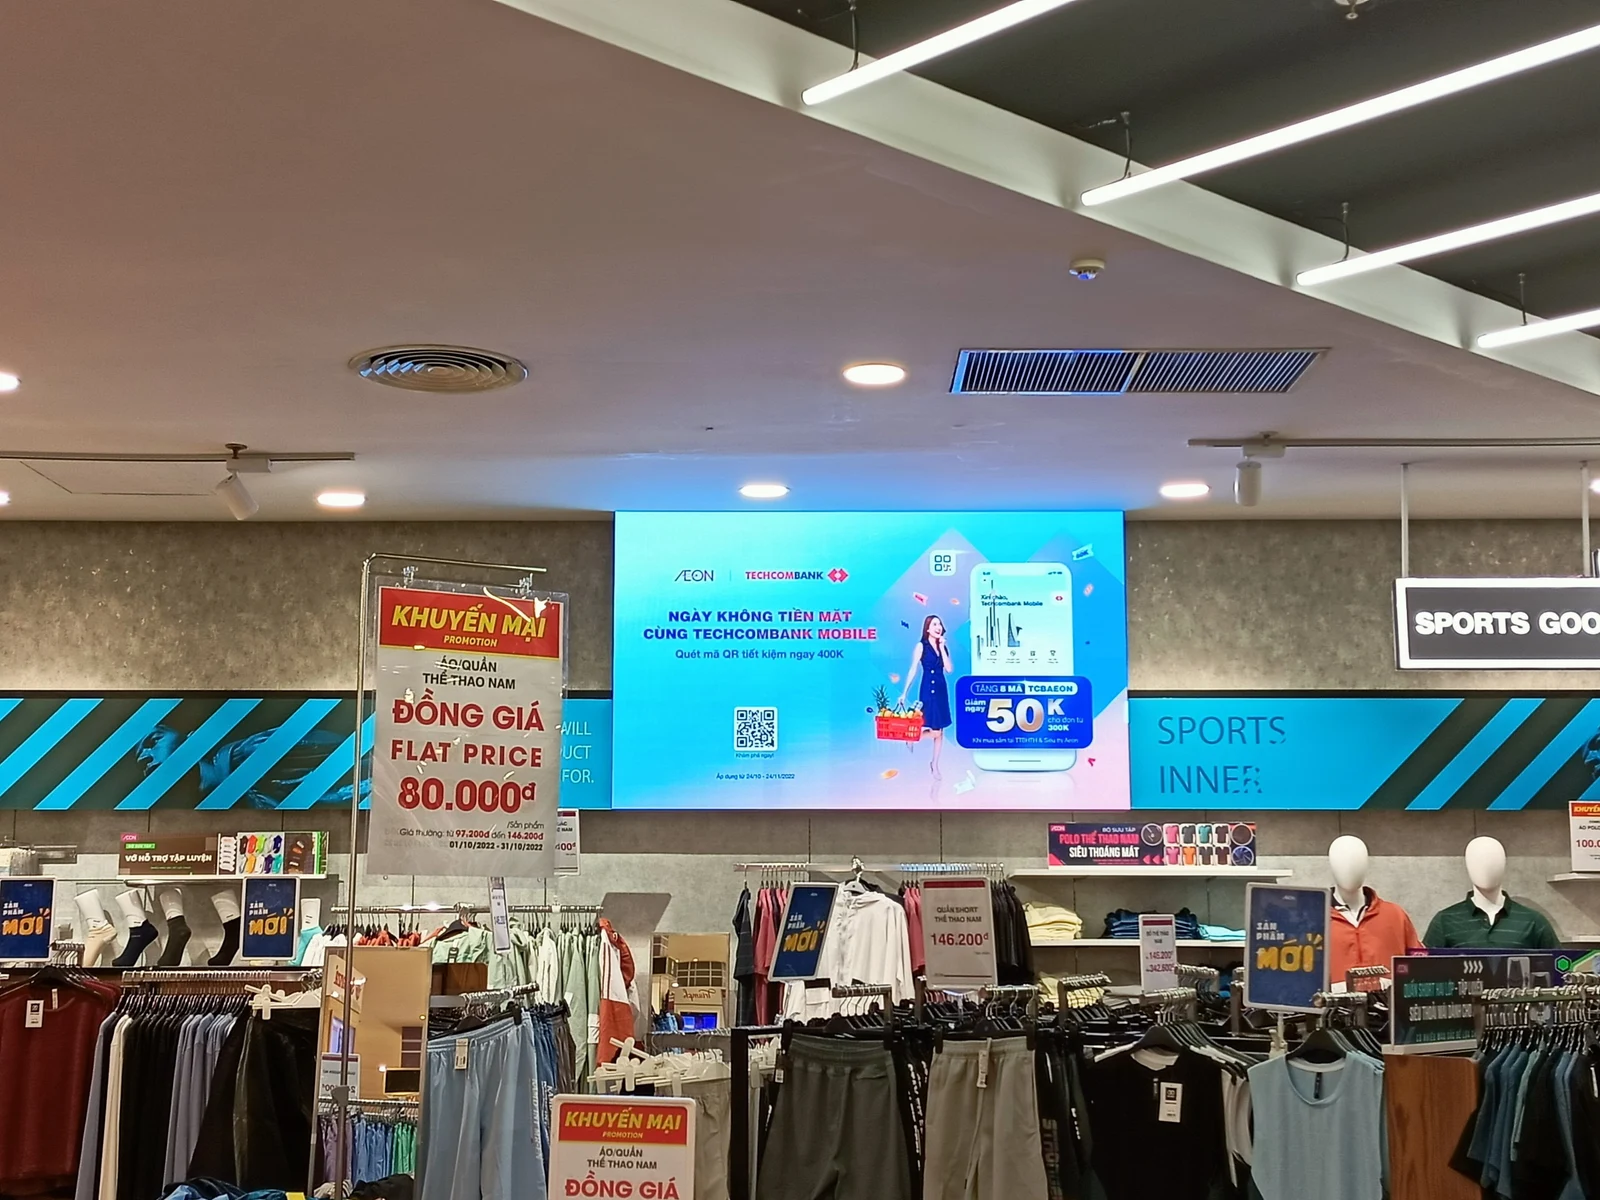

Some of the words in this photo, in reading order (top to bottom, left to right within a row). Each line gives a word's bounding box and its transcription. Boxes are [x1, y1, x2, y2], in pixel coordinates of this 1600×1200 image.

[746, 571, 824, 580] TECHCOMBANK
[392, 604, 498, 634] KHUYẾN
[501, 614, 546, 642] MẠI
[669, 608, 712, 622] NGÀY
[717, 608, 772, 622] KHÔNG
[778, 607, 814, 622] TIỀN
[819, 610, 852, 624] MẶT
[1415, 611, 1530, 634] SPORTS
[443, 634, 498, 647] PROMOTION
[644, 625, 688, 640] CÙNG
[693, 628, 812, 640] TECHCOMBANK
[818, 628, 877, 640] MOBILE
[676, 649, 700, 659] Quét
[704, 650, 719, 658] mã
[723, 650, 739, 659] QR
[742, 648, 759, 658] tiết
[762, 649, 786, 660] kiệm
[790, 651, 814, 661] ngay
[817, 650, 844, 658] 400K
[422, 670, 447, 685] THỂ
[452, 675, 485, 687] THAO
[488, 678, 516, 689] NAM
[392, 688, 484, 727] ĐỒNG
[492, 700, 544, 732] GIÁ
[986, 698, 1044, 732] 50
[1048, 698, 1065, 715] K
[1158, 716, 1286, 744] SPORTS
[391, 740, 452, 763] FLAT
[464, 743, 542, 768] PRICE
[562, 769, 594, 783] FOR.
[1160, 766, 1262, 794] INNER
[398, 776, 536, 813] 80.000đ
[455, 830, 490, 838] 97.200đ
[508, 831, 544, 840] 146.200đ
[524, 821, 544, 830] phẩm
[450, 841, 495, 850] 01/10/2022
[501, 842, 543, 851] 31/10/2022
[1060, 834, 1080, 844] POLO
[1081, 830, 1097, 844] THỂ
[138, 852, 150, 862] HỖ
[152, 854, 168, 863] TRỢ
[170, 853, 185, 863] TẬP
[187, 853, 212, 862] LUYỆN
[1069, 845, 1088, 858] SIÊU
[1088, 845, 1120, 857] THOÁNG
[1122, 845, 1140, 857] MÁT
[2, 912, 43, 935] MỚI
[249, 912, 287, 935] MỚI
[783, 926, 818, 952] MỚI
[931, 933, 988, 946] 146.200đ
[1256, 939, 1313, 972] MỚI
[565, 1107, 643, 1128] KHUYẾN
[647, 1114, 682, 1134] MẠI
[587, 1156, 606, 1168] THỂ
[608, 1160, 633, 1169] THAO
[636, 1161, 657, 1170] NAM
[565, 1170, 633, 1198] ĐỒNG
[639, 1177, 679, 1199] GIÁ
